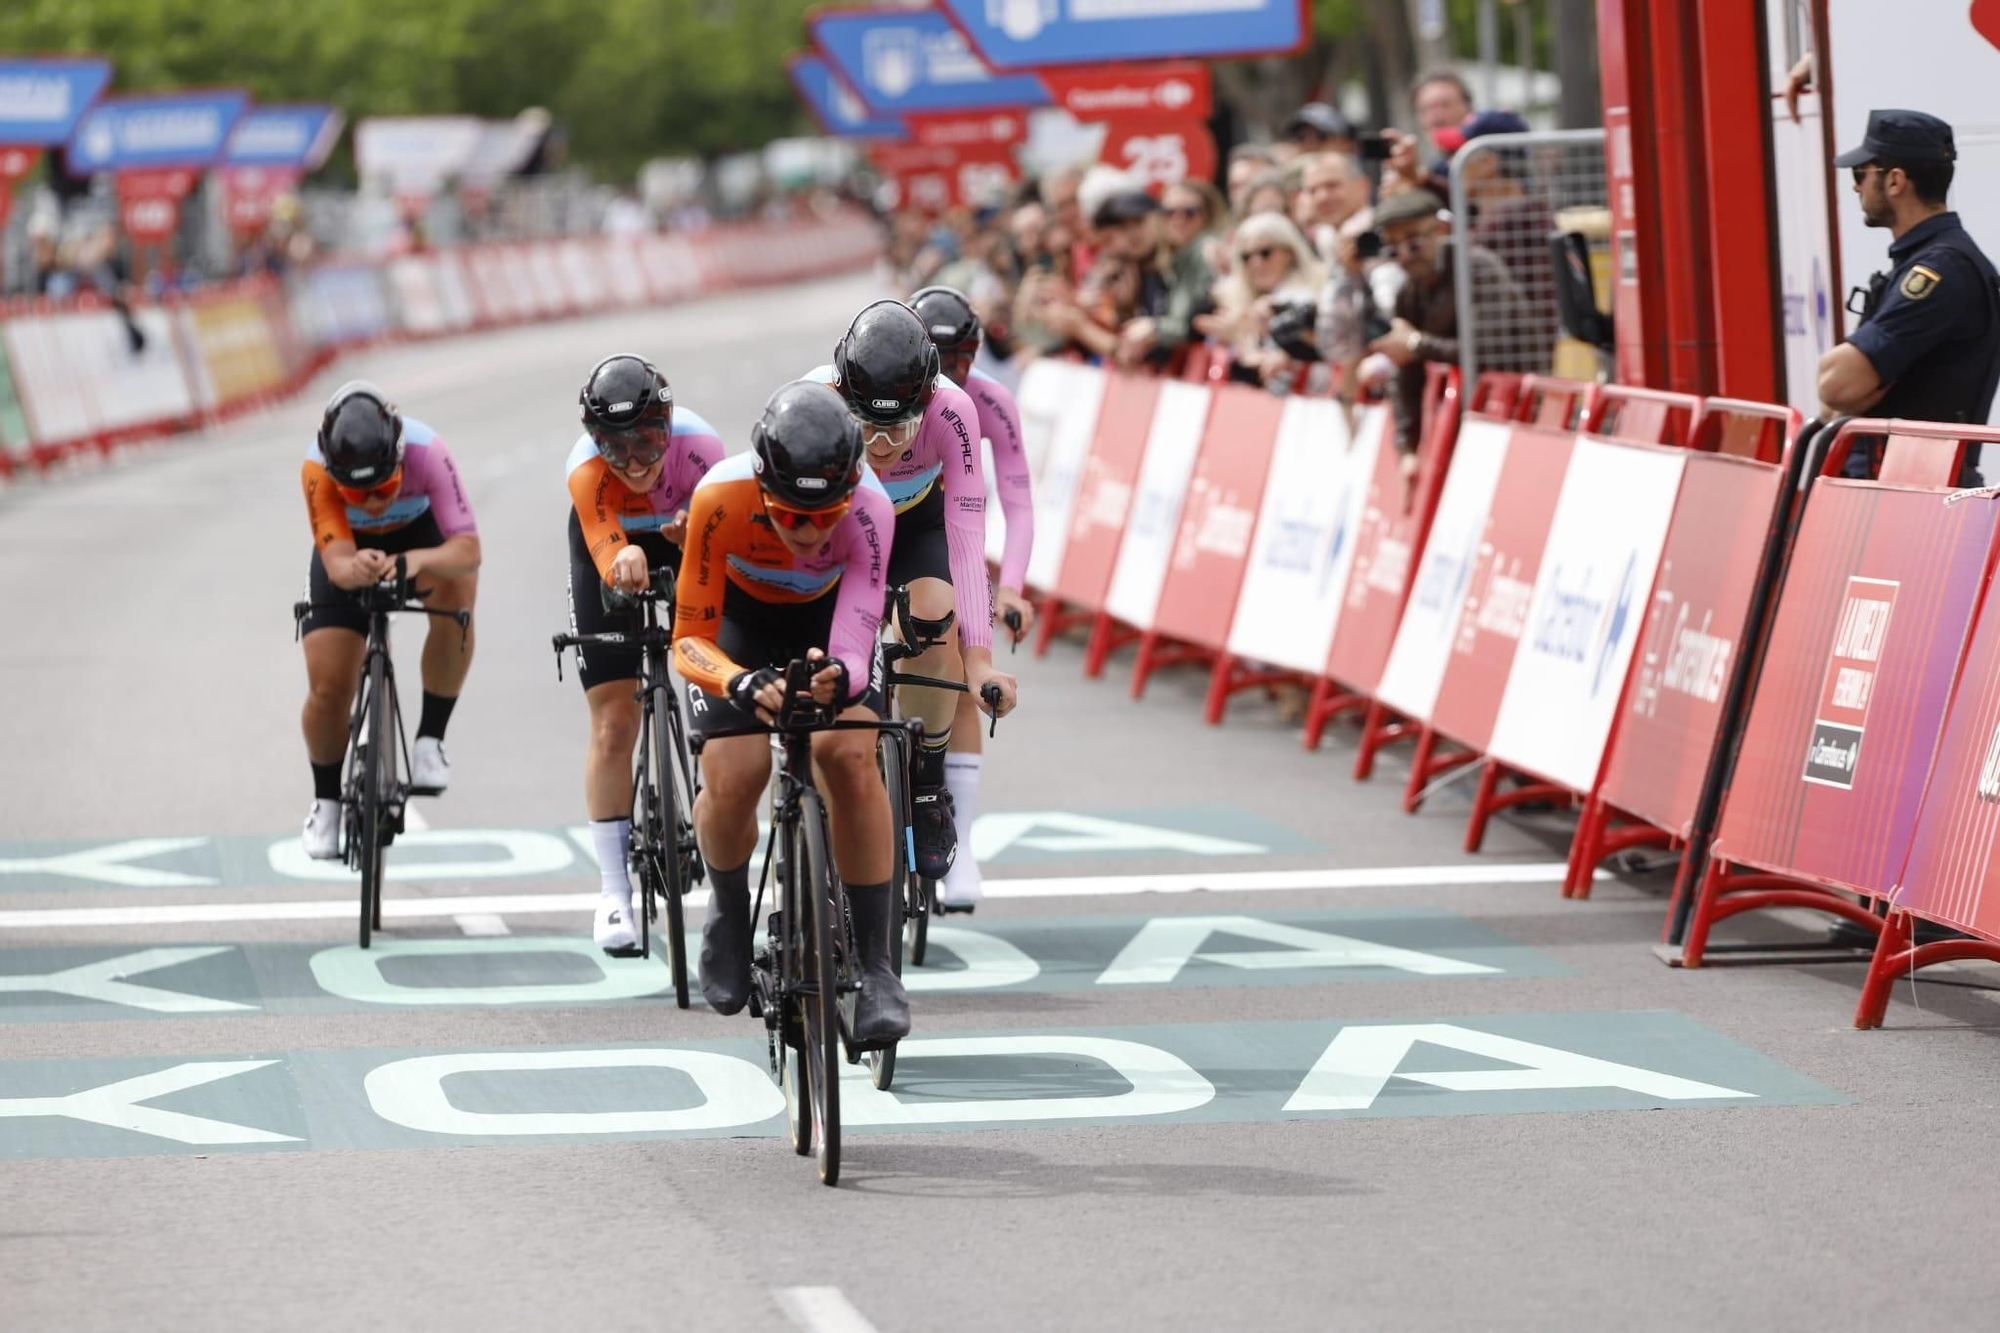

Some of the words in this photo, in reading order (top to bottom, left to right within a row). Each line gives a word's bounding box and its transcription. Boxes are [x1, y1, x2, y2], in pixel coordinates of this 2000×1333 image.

[941, 406, 974, 475] WINSPACE
[698, 504, 727, 586] WINSPACE
[854, 506, 882, 590] WINSPACE
